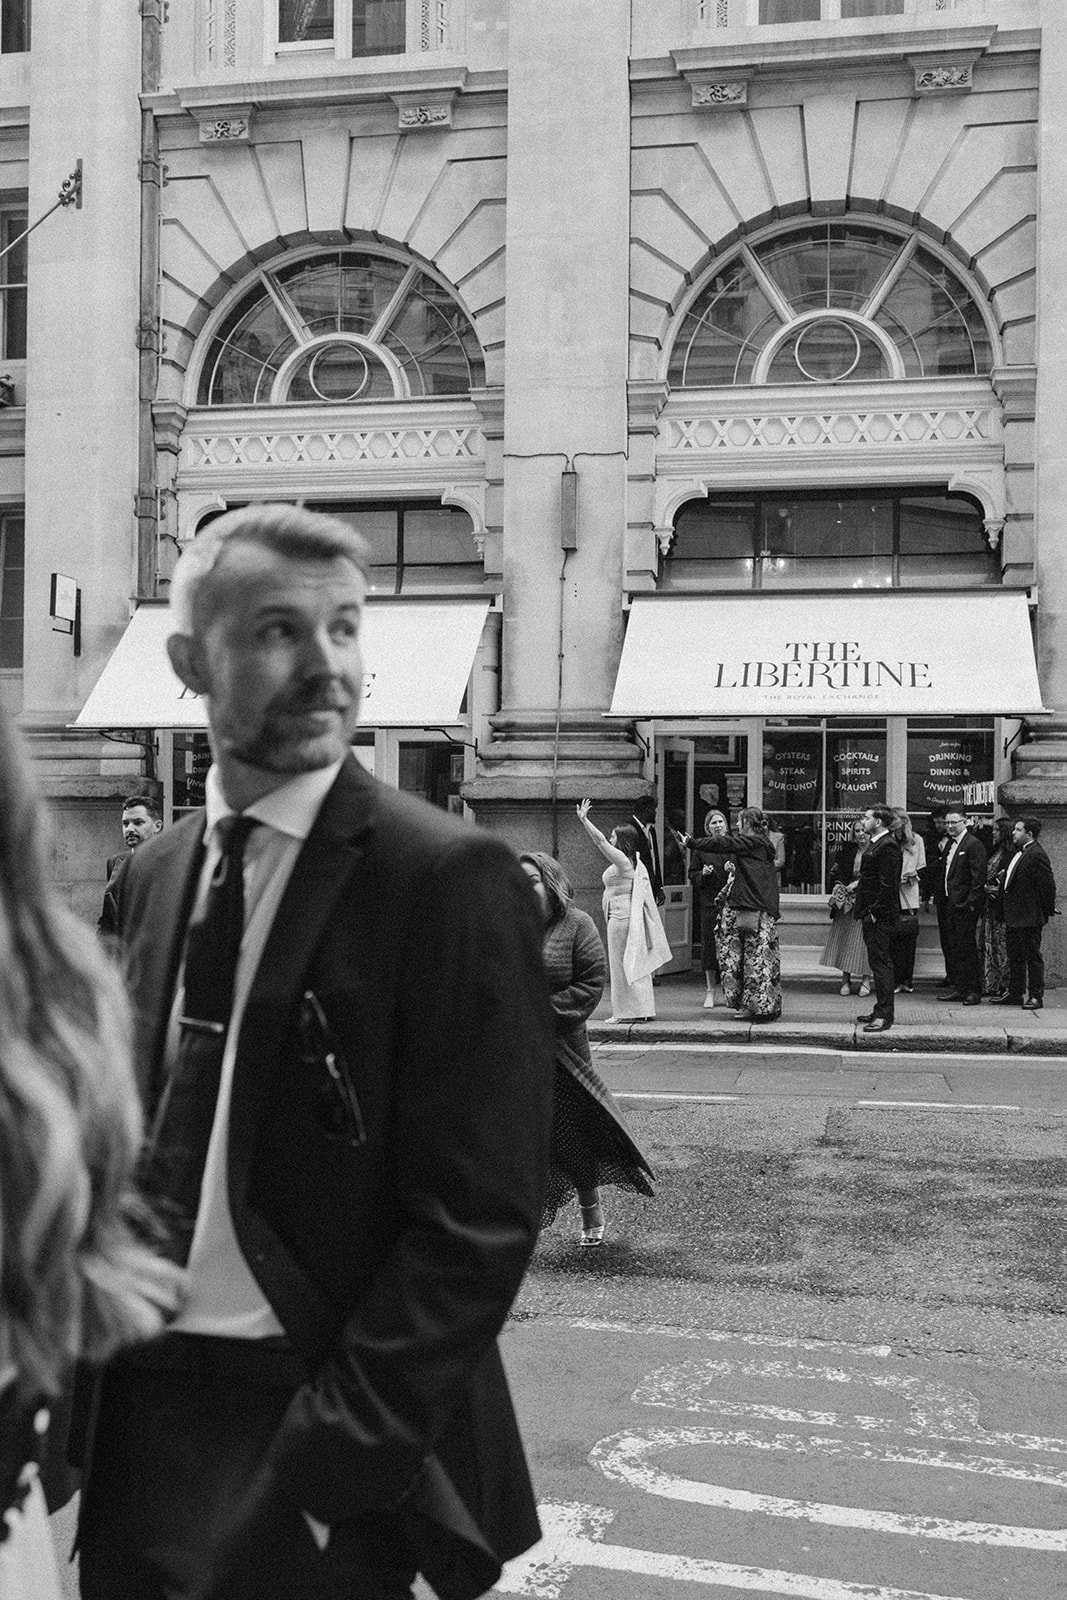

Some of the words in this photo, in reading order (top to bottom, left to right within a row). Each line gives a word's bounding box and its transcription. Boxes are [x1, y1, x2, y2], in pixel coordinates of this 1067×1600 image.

[785, 642, 861, 661] THE
[714, 661, 933, 690] LIBERTINE
[775, 751, 811, 761] OYSTERS
[833, 751, 880, 763] COCKTAILS
[928, 752, 972, 763] DRINKING
[779, 767, 806, 775] STEAK
[841, 767, 871, 775] SPIRITS
[930, 768, 962, 776] DINING
[768, 780, 818, 791] BURGUNDY
[834, 781, 878, 792] DRAUGHT
